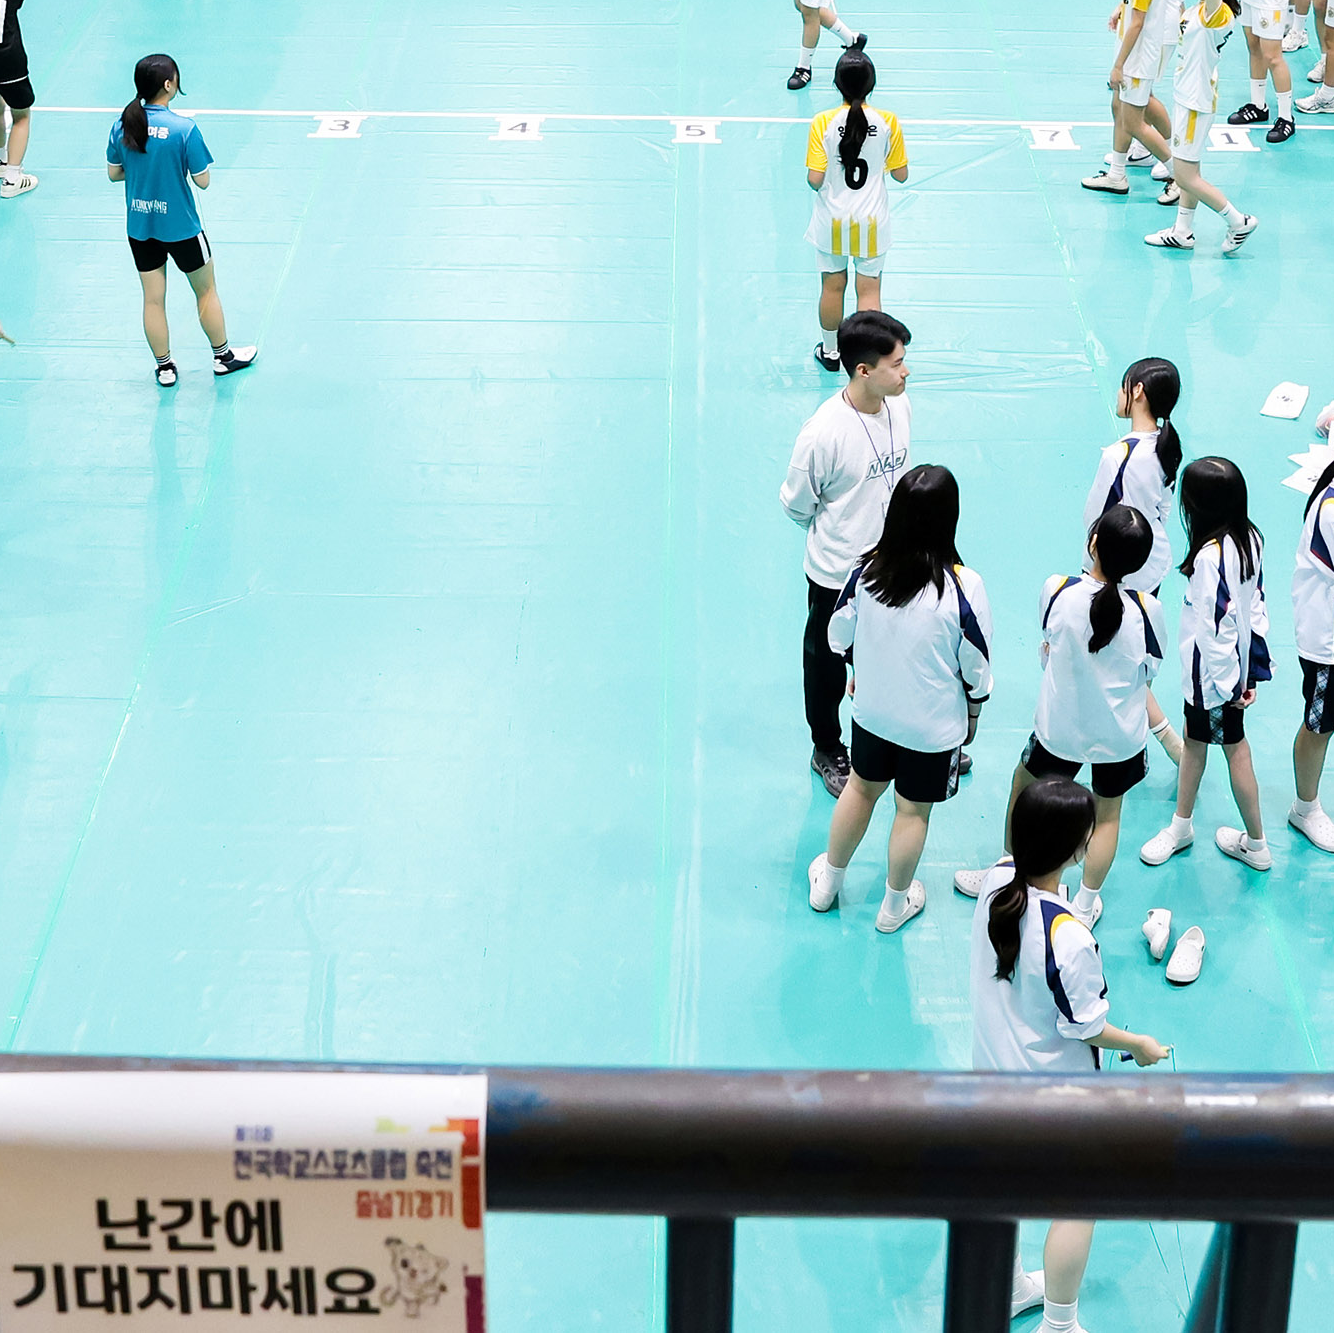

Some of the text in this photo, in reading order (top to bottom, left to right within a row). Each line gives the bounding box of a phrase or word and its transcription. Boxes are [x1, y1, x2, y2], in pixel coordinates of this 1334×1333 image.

[329, 120, 350, 131] 3
[510, 122, 530, 133] 4
[685, 125, 705, 136] 5
[1221, 133, 1237, 144] 1
[233, 1148, 454, 1180] 전국학교스포츠클럽 축전
[355, 1190, 455, 1219] 줄넘기경기
[95, 1198, 284, 1253] 난간에
[12, 1263, 381, 1316] 기대지마세요
